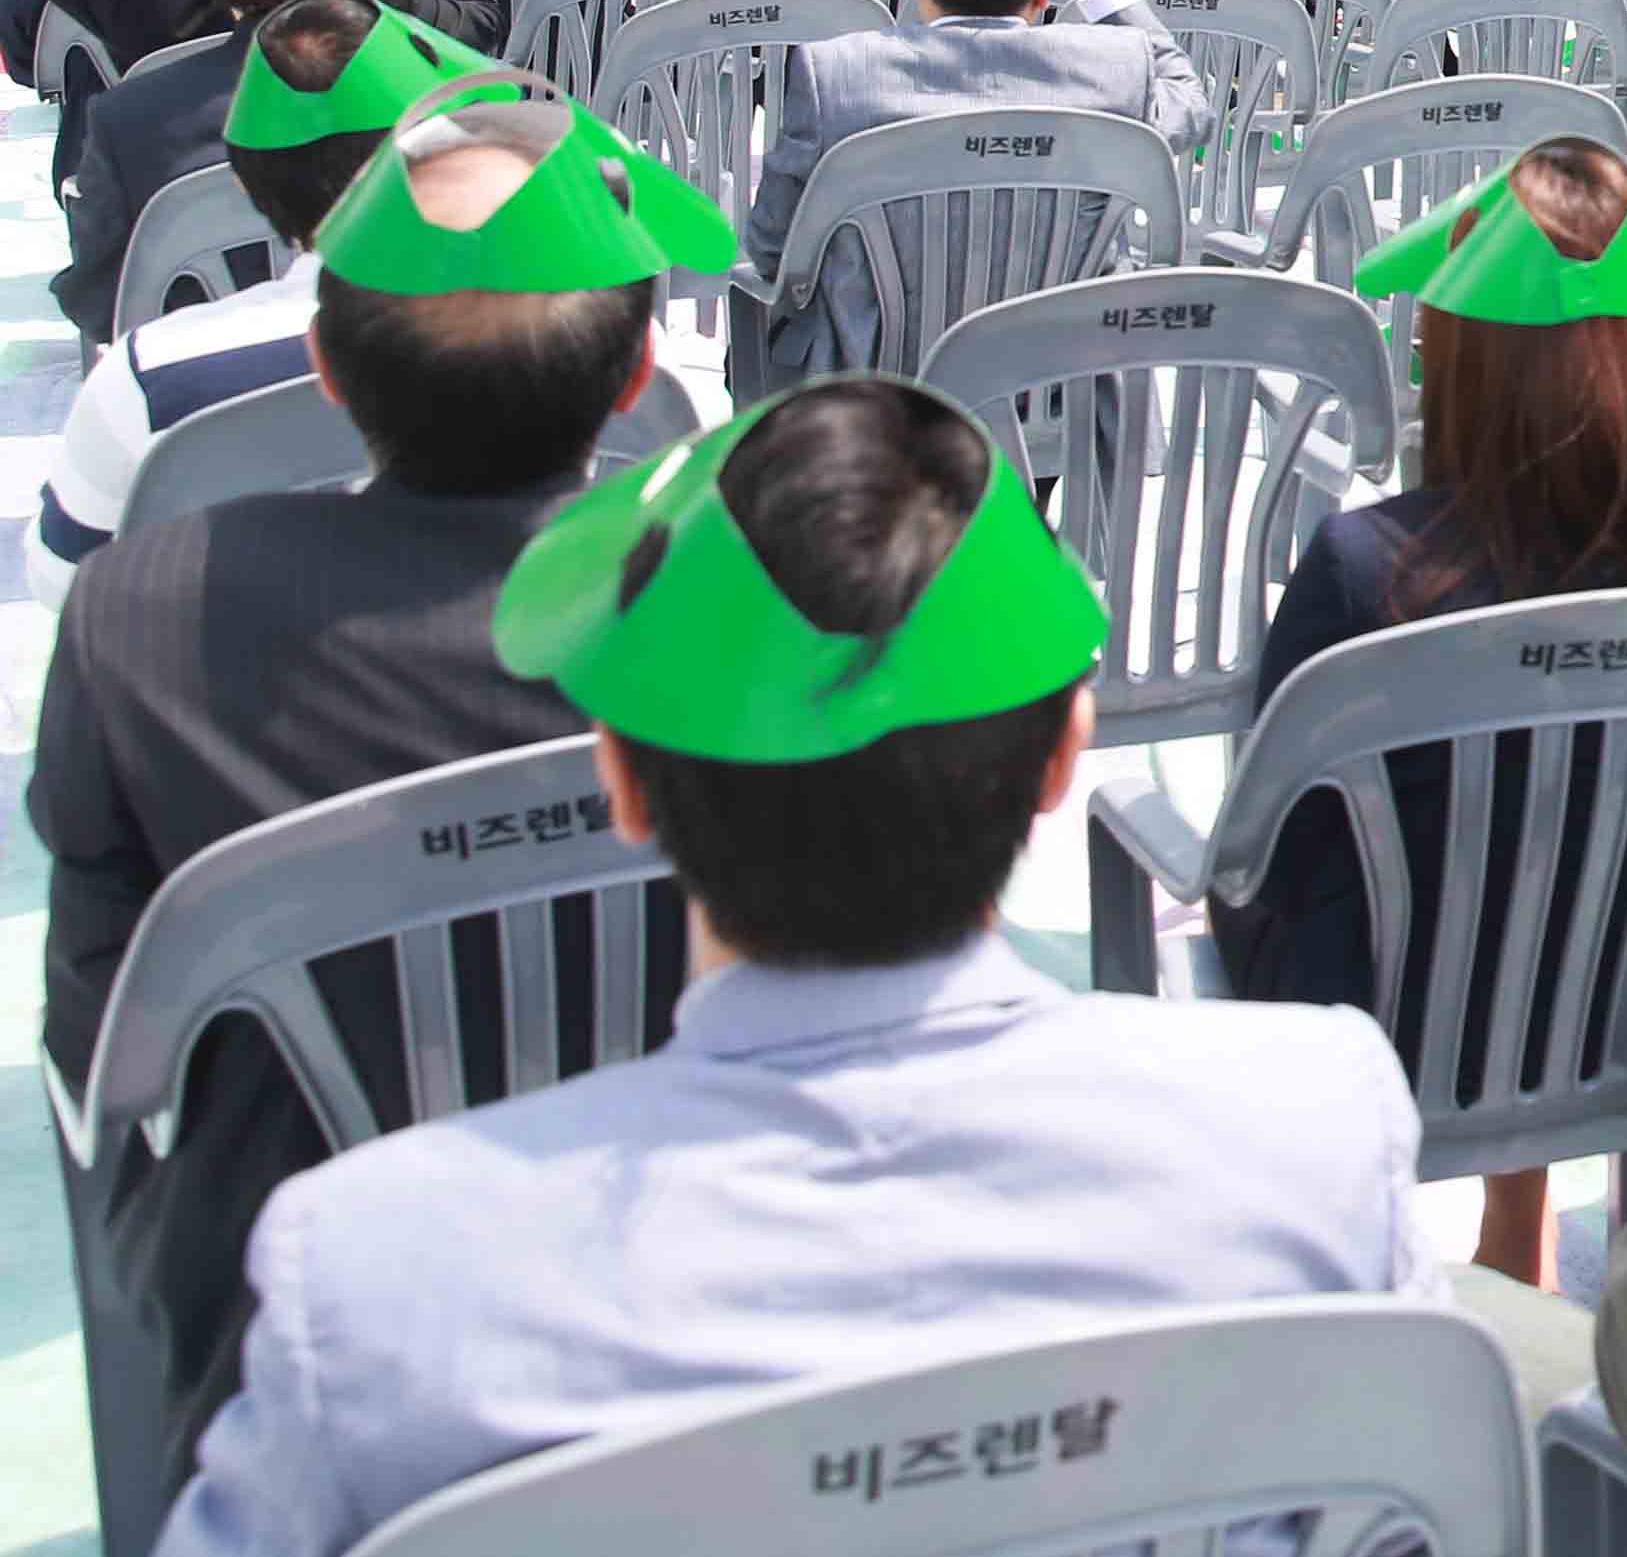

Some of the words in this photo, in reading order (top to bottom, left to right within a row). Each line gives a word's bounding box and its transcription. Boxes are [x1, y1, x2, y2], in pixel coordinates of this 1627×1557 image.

[709, 5, 782, 28] 비즈렌탈
[1422, 102, 1503, 125] 비즈렌탈
[964, 135, 1055, 156] 비즈렌탈
[1101, 302, 1216, 334] 비즈렌탈
[813, 1395, 1122, 1504] 비즈렌탈
